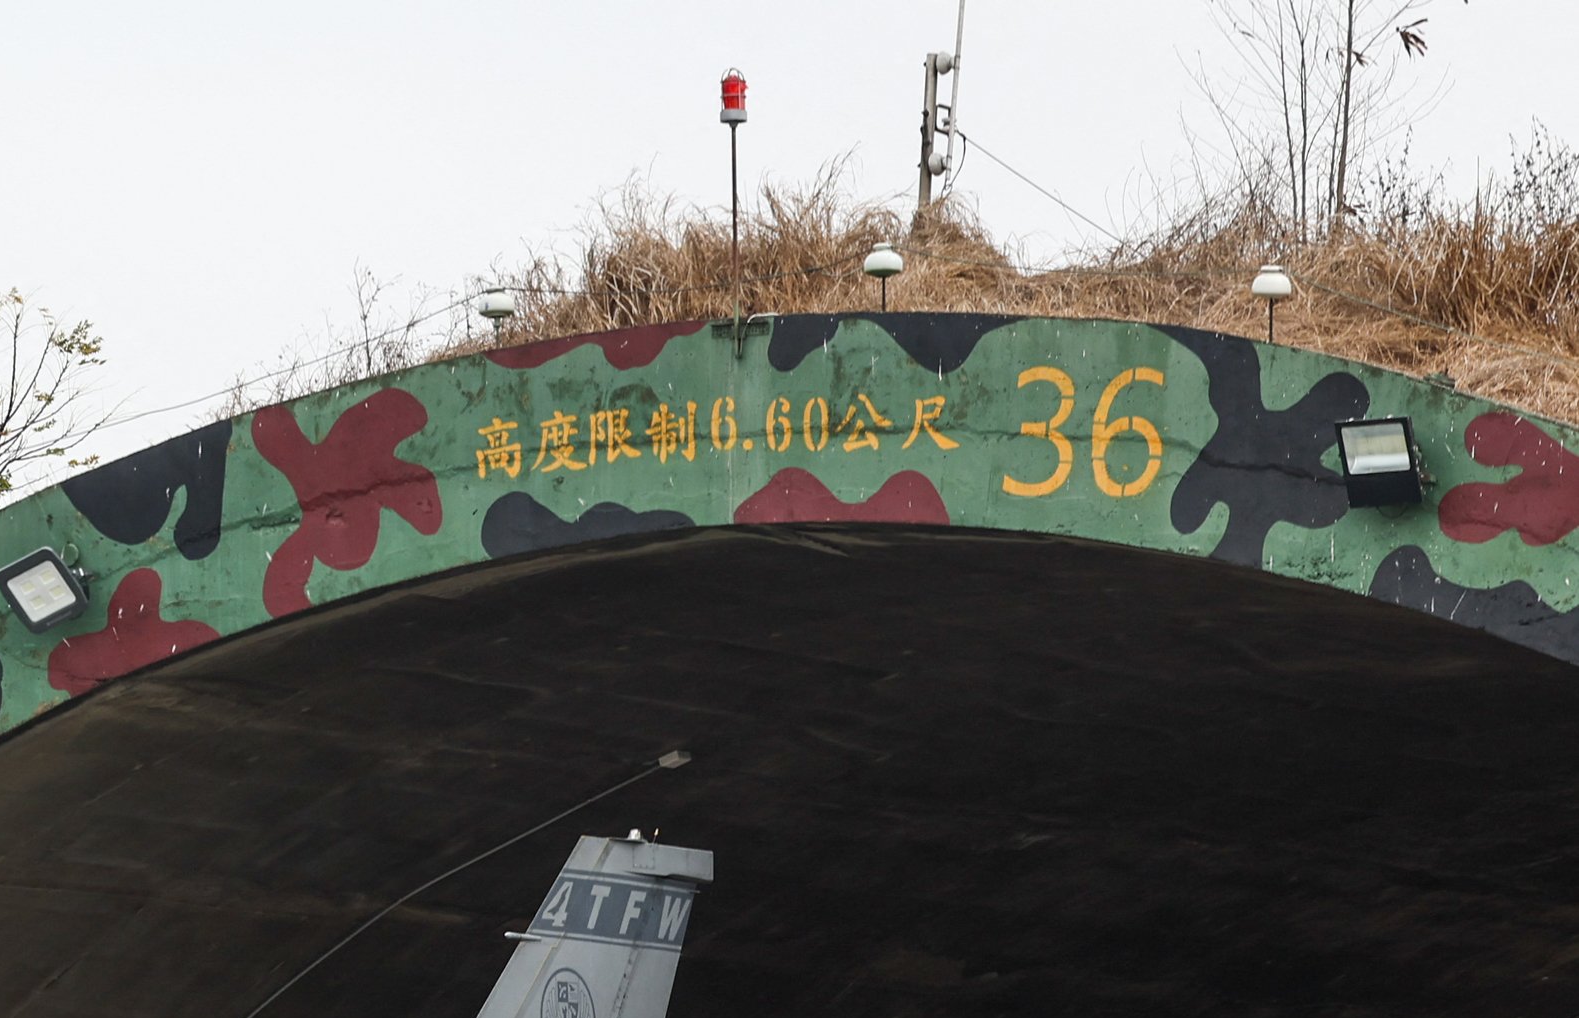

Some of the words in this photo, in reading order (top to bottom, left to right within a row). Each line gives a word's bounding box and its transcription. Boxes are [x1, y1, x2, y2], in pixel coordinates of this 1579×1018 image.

[475, 393, 960, 479] 高度限制6.60公尺
[1002, 366, 1165, 498] 36
